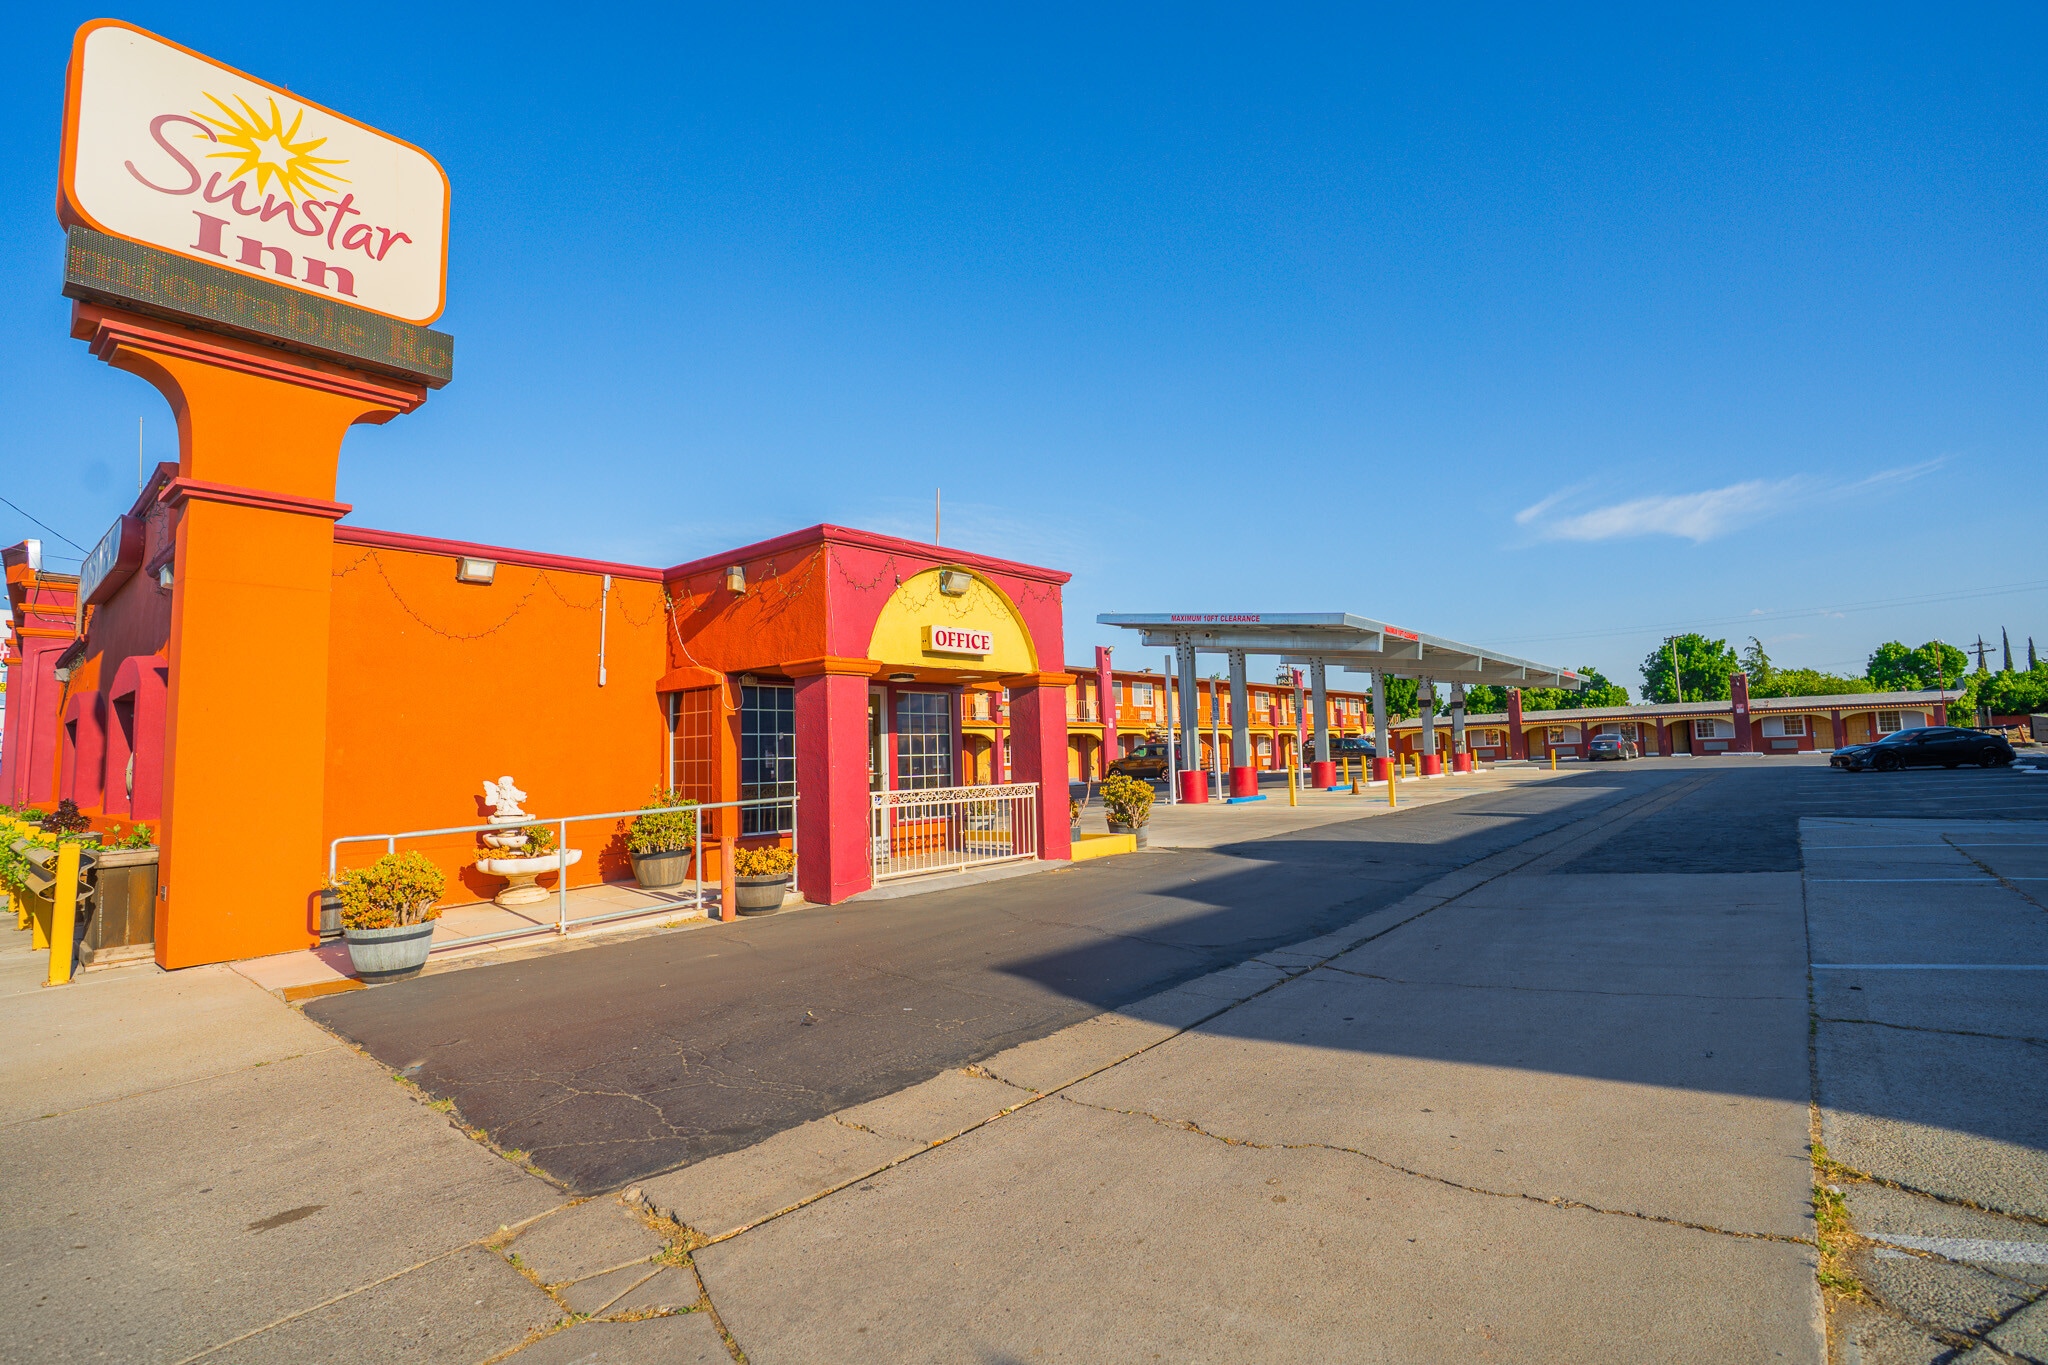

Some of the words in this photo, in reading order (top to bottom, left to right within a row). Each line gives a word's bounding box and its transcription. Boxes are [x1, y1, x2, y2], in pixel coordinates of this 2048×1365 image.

[124, 113, 413, 262] Sunstar
[189, 209, 358, 299] Inn
[935, 630, 990, 651] OFFICE
[1171, 614, 1202, 622] MAXIMUM
[1203, 614, 1219, 622] 10FT
[1220, 614, 1261, 622] CLEARANCE
